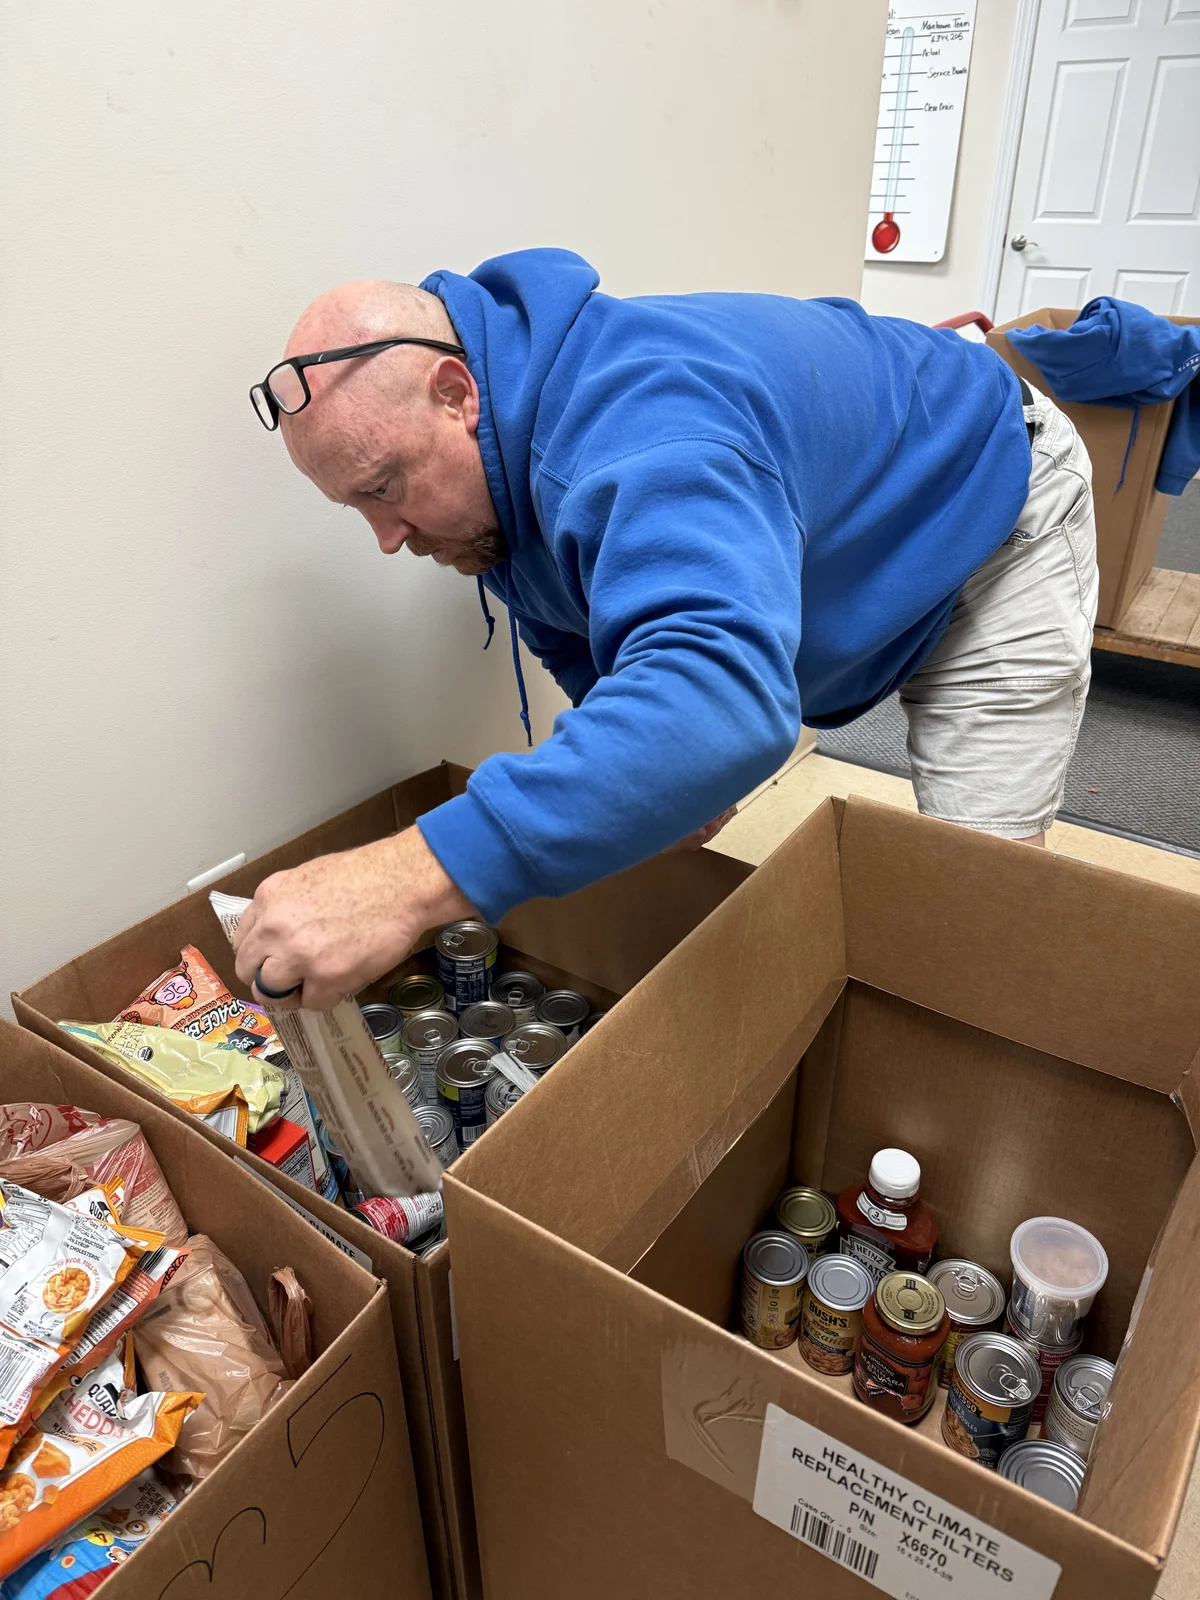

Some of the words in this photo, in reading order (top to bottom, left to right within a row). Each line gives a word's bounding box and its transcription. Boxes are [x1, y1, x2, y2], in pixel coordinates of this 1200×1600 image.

[953, 17, 970, 28] Team
[200, 1000, 246, 1033] SPACE
[69, 1245, 101, 1262] CHOLESTEROL
[74, 1240, 90, 1249] SYRUP
[82, 1237, 105, 1251] FRUCTOSE
[856, 1245, 884, 1264] HEINZ
[82, 1260, 94, 1271] FULL
[809, 1300, 848, 1328] BUSH'S
[803, 1317, 850, 1347] Organic
[861, 1352, 905, 1388] MARINARA
[868, 1355, 895, 1377] ORGANIC
[59, 1392, 138, 1438] HEDDA
[791, 1447, 928, 1533] REPLACEMENT
[932, 1529, 1014, 1583] FILTERS
[798, 1498, 818, 1514] Case
[820, 1511, 836, 1524] Qty
[822, 1447, 908, 1503] HEALTHY
[912, 1499, 1001, 1557] CLIMATE
[849, 1502, 876, 1527] P/N
[899, 1531, 947, 1568] X6670
[860, 1523, 878, 1540] Size:
